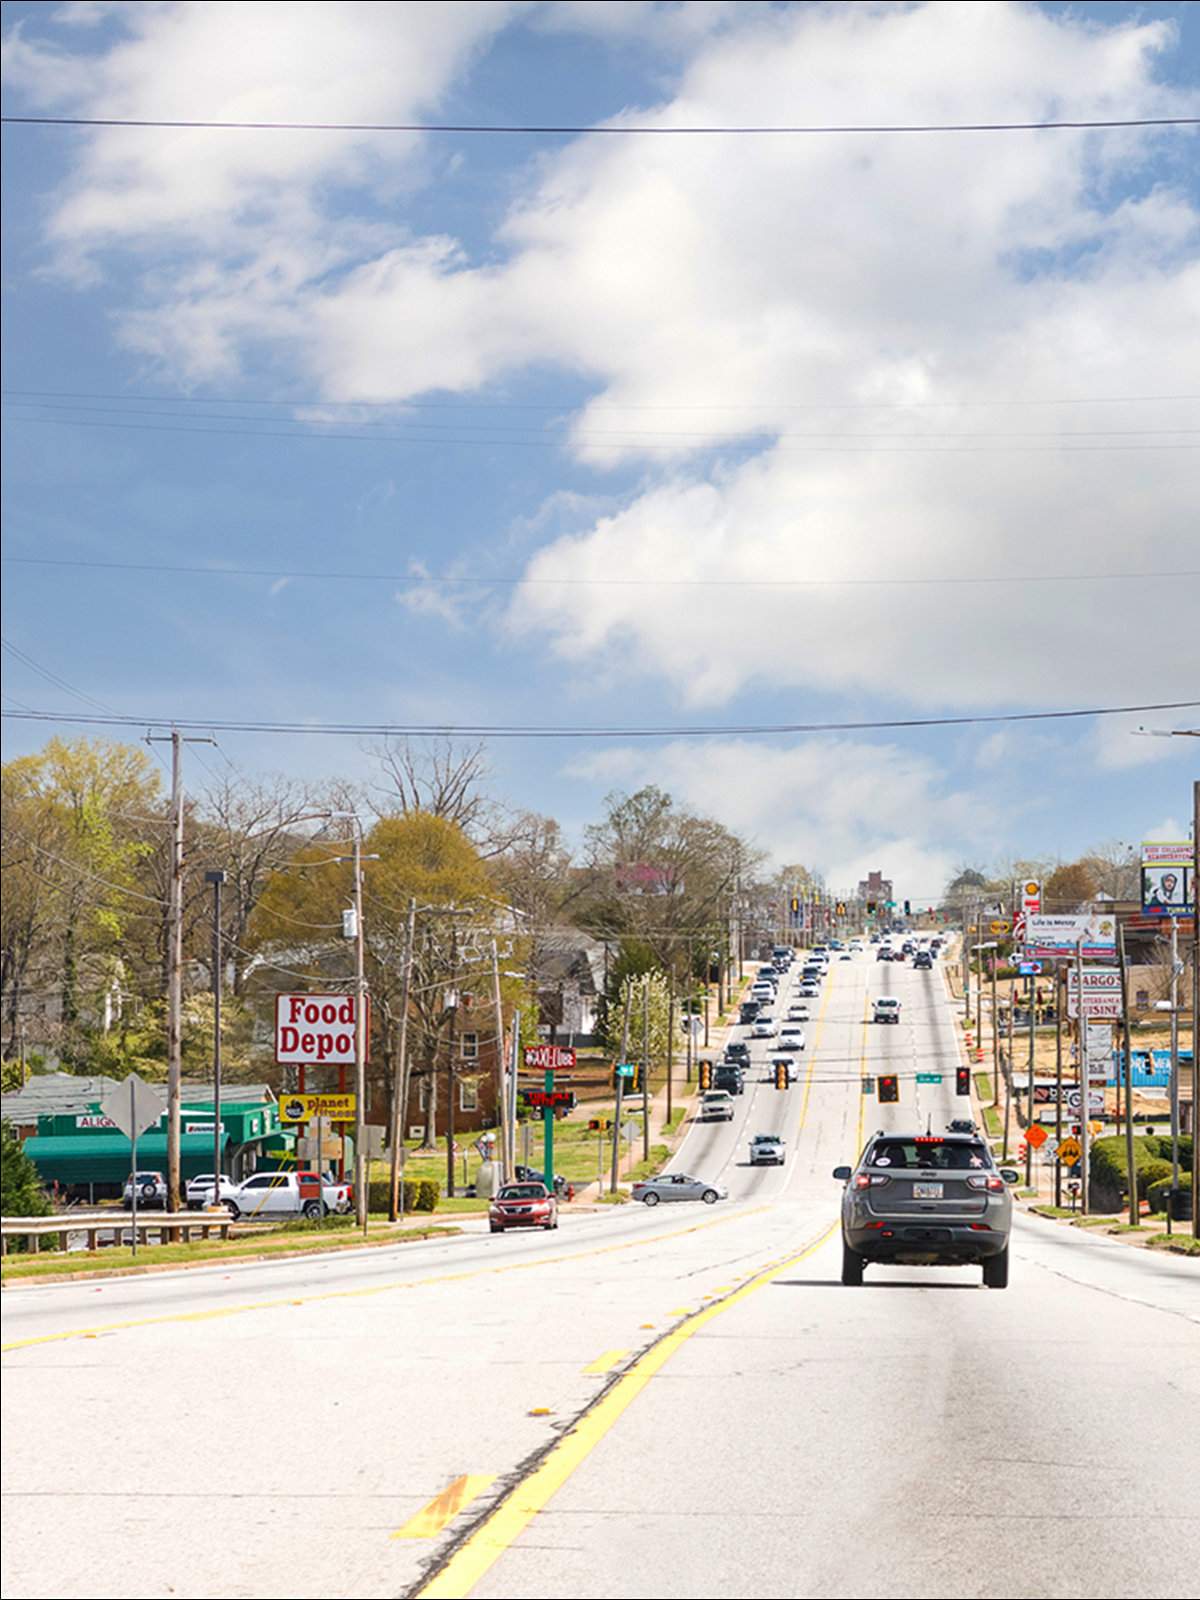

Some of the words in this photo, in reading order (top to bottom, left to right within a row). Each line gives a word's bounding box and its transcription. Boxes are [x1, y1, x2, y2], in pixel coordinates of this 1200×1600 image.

[289, 997, 355, 1024] Food
[280, 1026, 356, 1060] Depo
[307, 1097, 349, 1110] planet
